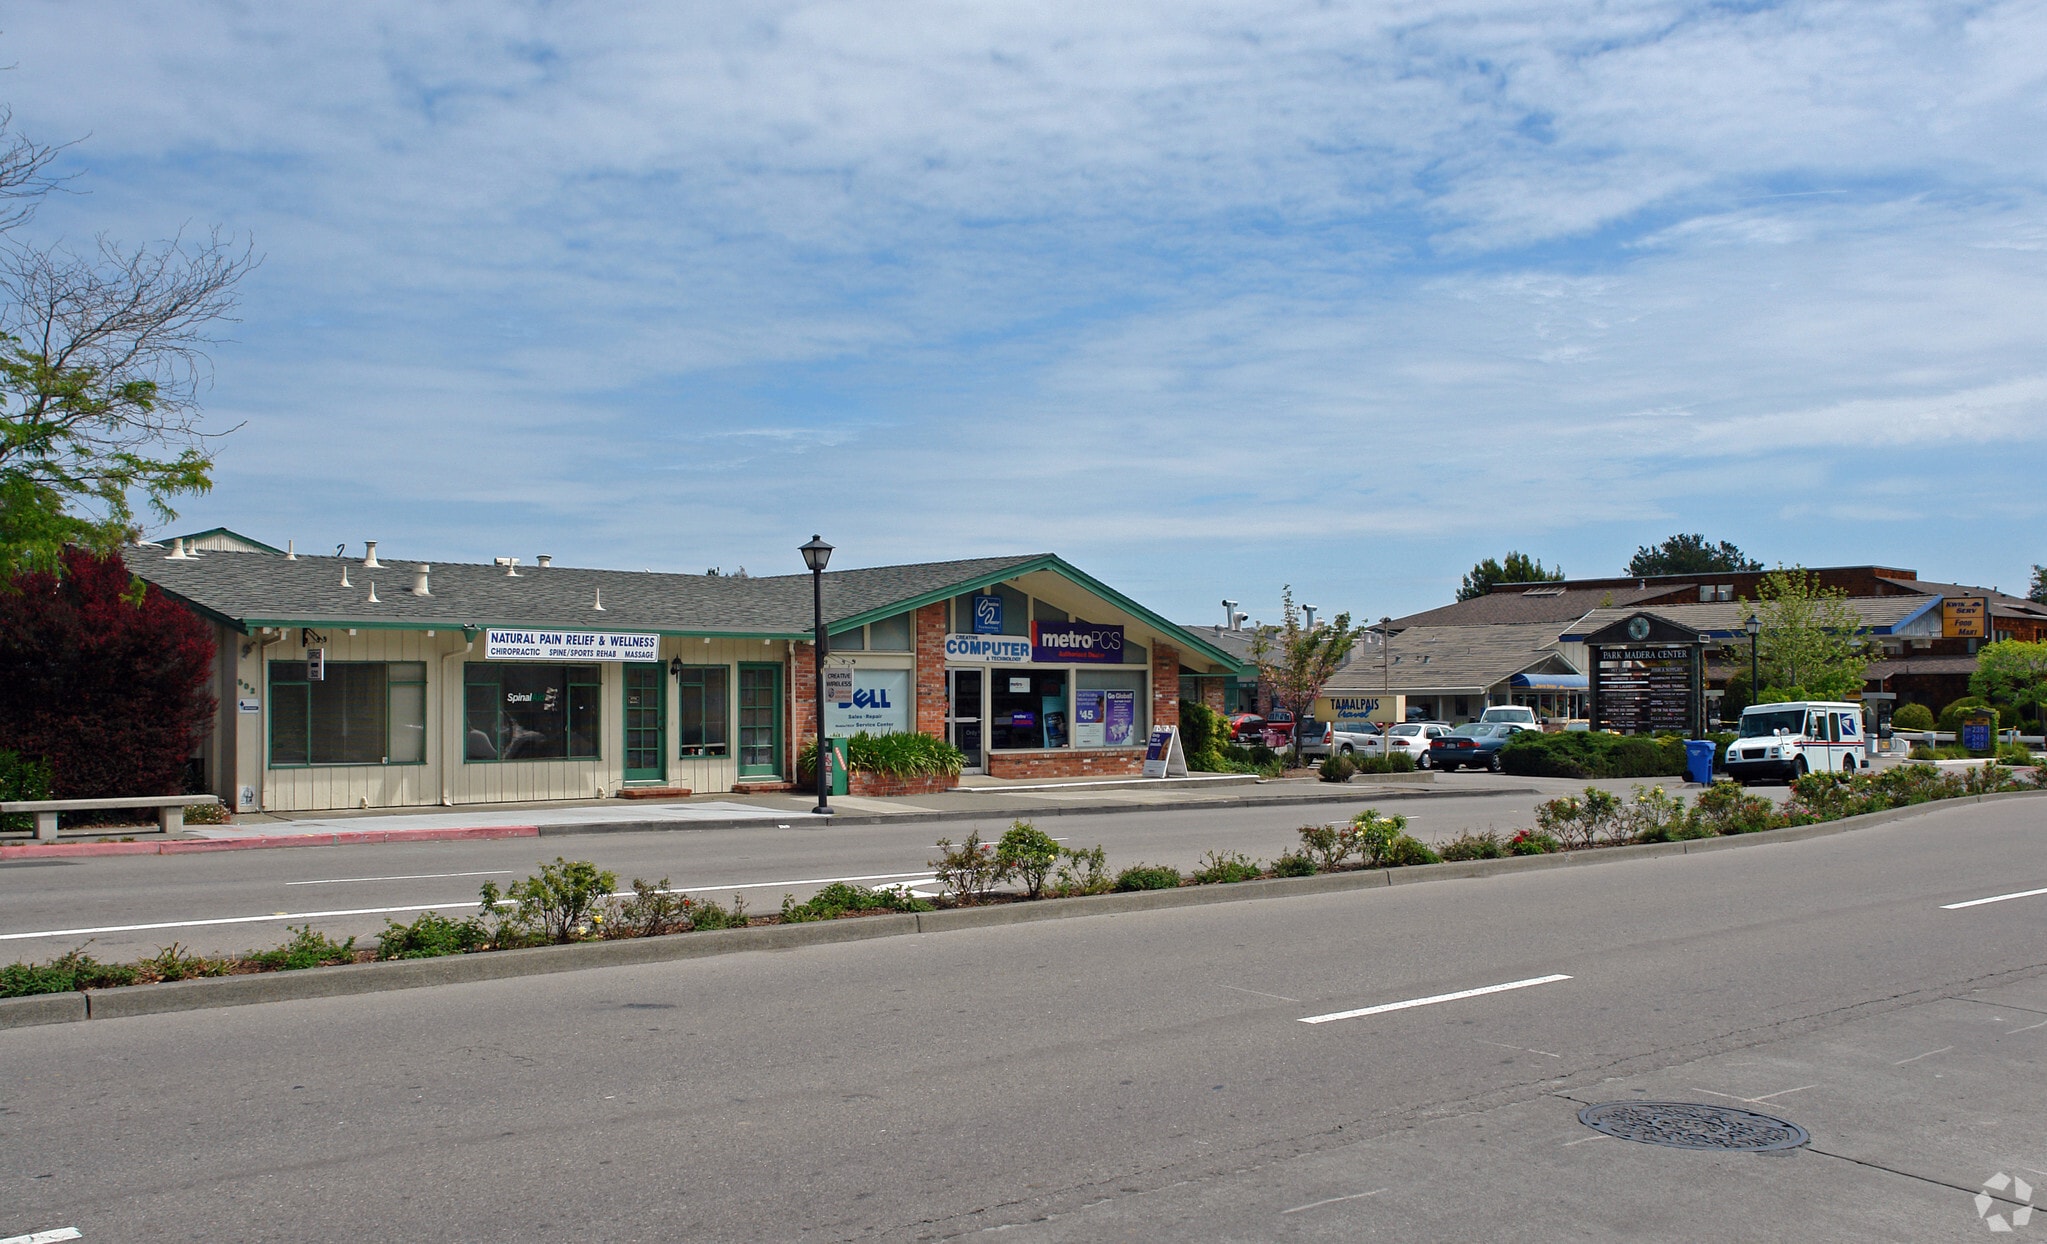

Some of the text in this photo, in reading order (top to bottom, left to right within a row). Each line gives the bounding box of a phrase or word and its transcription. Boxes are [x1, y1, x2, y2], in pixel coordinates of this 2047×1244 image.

[491, 633, 655, 648] NATURAL PAIN RELIEF & WELLNESS
[946, 640, 1030, 656] COMPUTER
[1042, 631, 1121, 650] metroPCS
[490, 647, 654, 659] CHIROPRACTIC SPINE/SPORTS REHAB MASSAGE
[1603, 650, 1688, 659] PARK MADERA CENTER
[838, 688, 891, 709] ELL
[1330, 699, 1380, 710] TAMALPAIS
